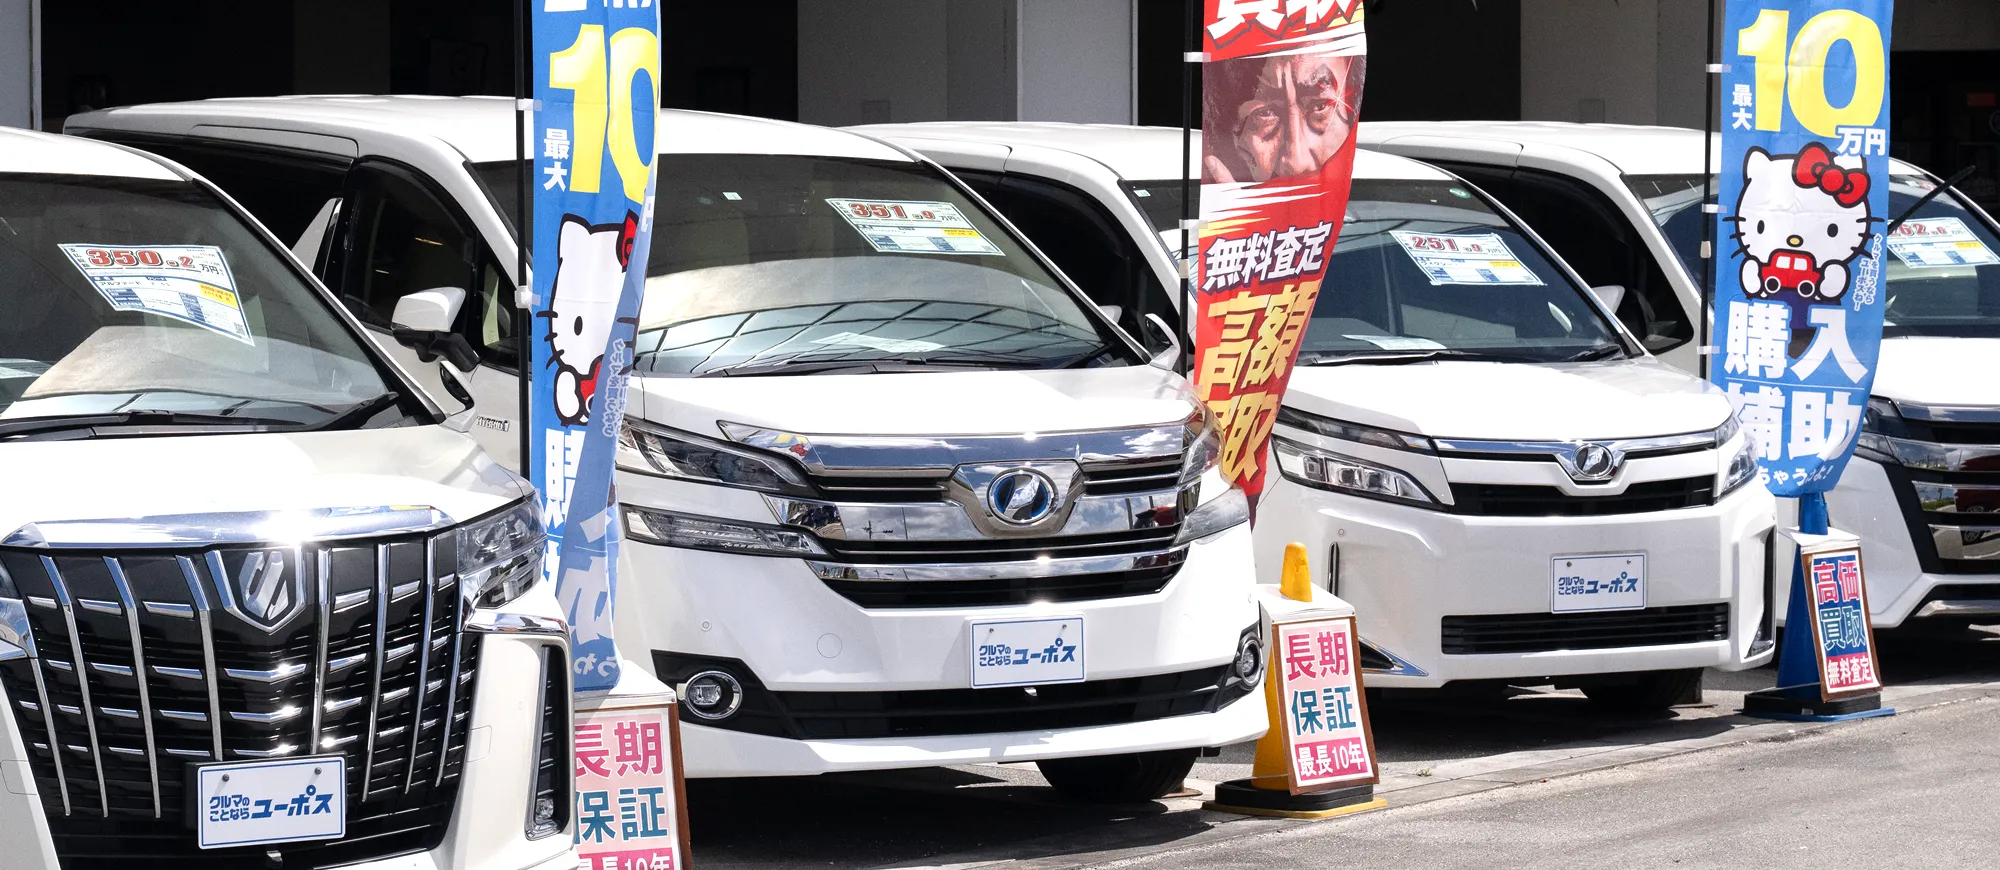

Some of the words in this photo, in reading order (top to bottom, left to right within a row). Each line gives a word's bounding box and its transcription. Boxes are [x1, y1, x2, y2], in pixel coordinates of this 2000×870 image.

[1738, 9, 1886, 139] 10
[1732, 84, 1752, 130] 最大
[543, 128, 570, 192] 最大
[1837, 127, 1886, 156] 万円
[1201, 221, 1332, 291] 無料査定
[1199, 279, 1322, 401] 高額
[1724, 300, 1868, 384] 購入
[1727, 382, 1863, 461] 補助
[1558, 576, 1584, 586] クルマの
[1558, 586, 1584, 595] ことなら
[1585, 571, 1638, 594] ユーポス
[1814, 560, 1860, 604] 高価
[979, 644, 1011, 655] クルマの
[1820, 605, 1866, 650] 買取
[979, 655, 1011, 667] ことなら
[1012, 637, 1077, 665] ユーポス
[1285, 631, 1349, 682] 長期
[1827, 655, 1873, 686] 無料査定
[1291, 686, 1357, 736] 保証
[575, 721, 664, 778] 長期
[1298, 741, 1365, 777] 最長10年
[209, 794, 250, 809] クルマの
[209, 808, 250, 822] ことなら
[251, 784, 333, 819] ユーポス
[575, 786, 668, 844] 保証
